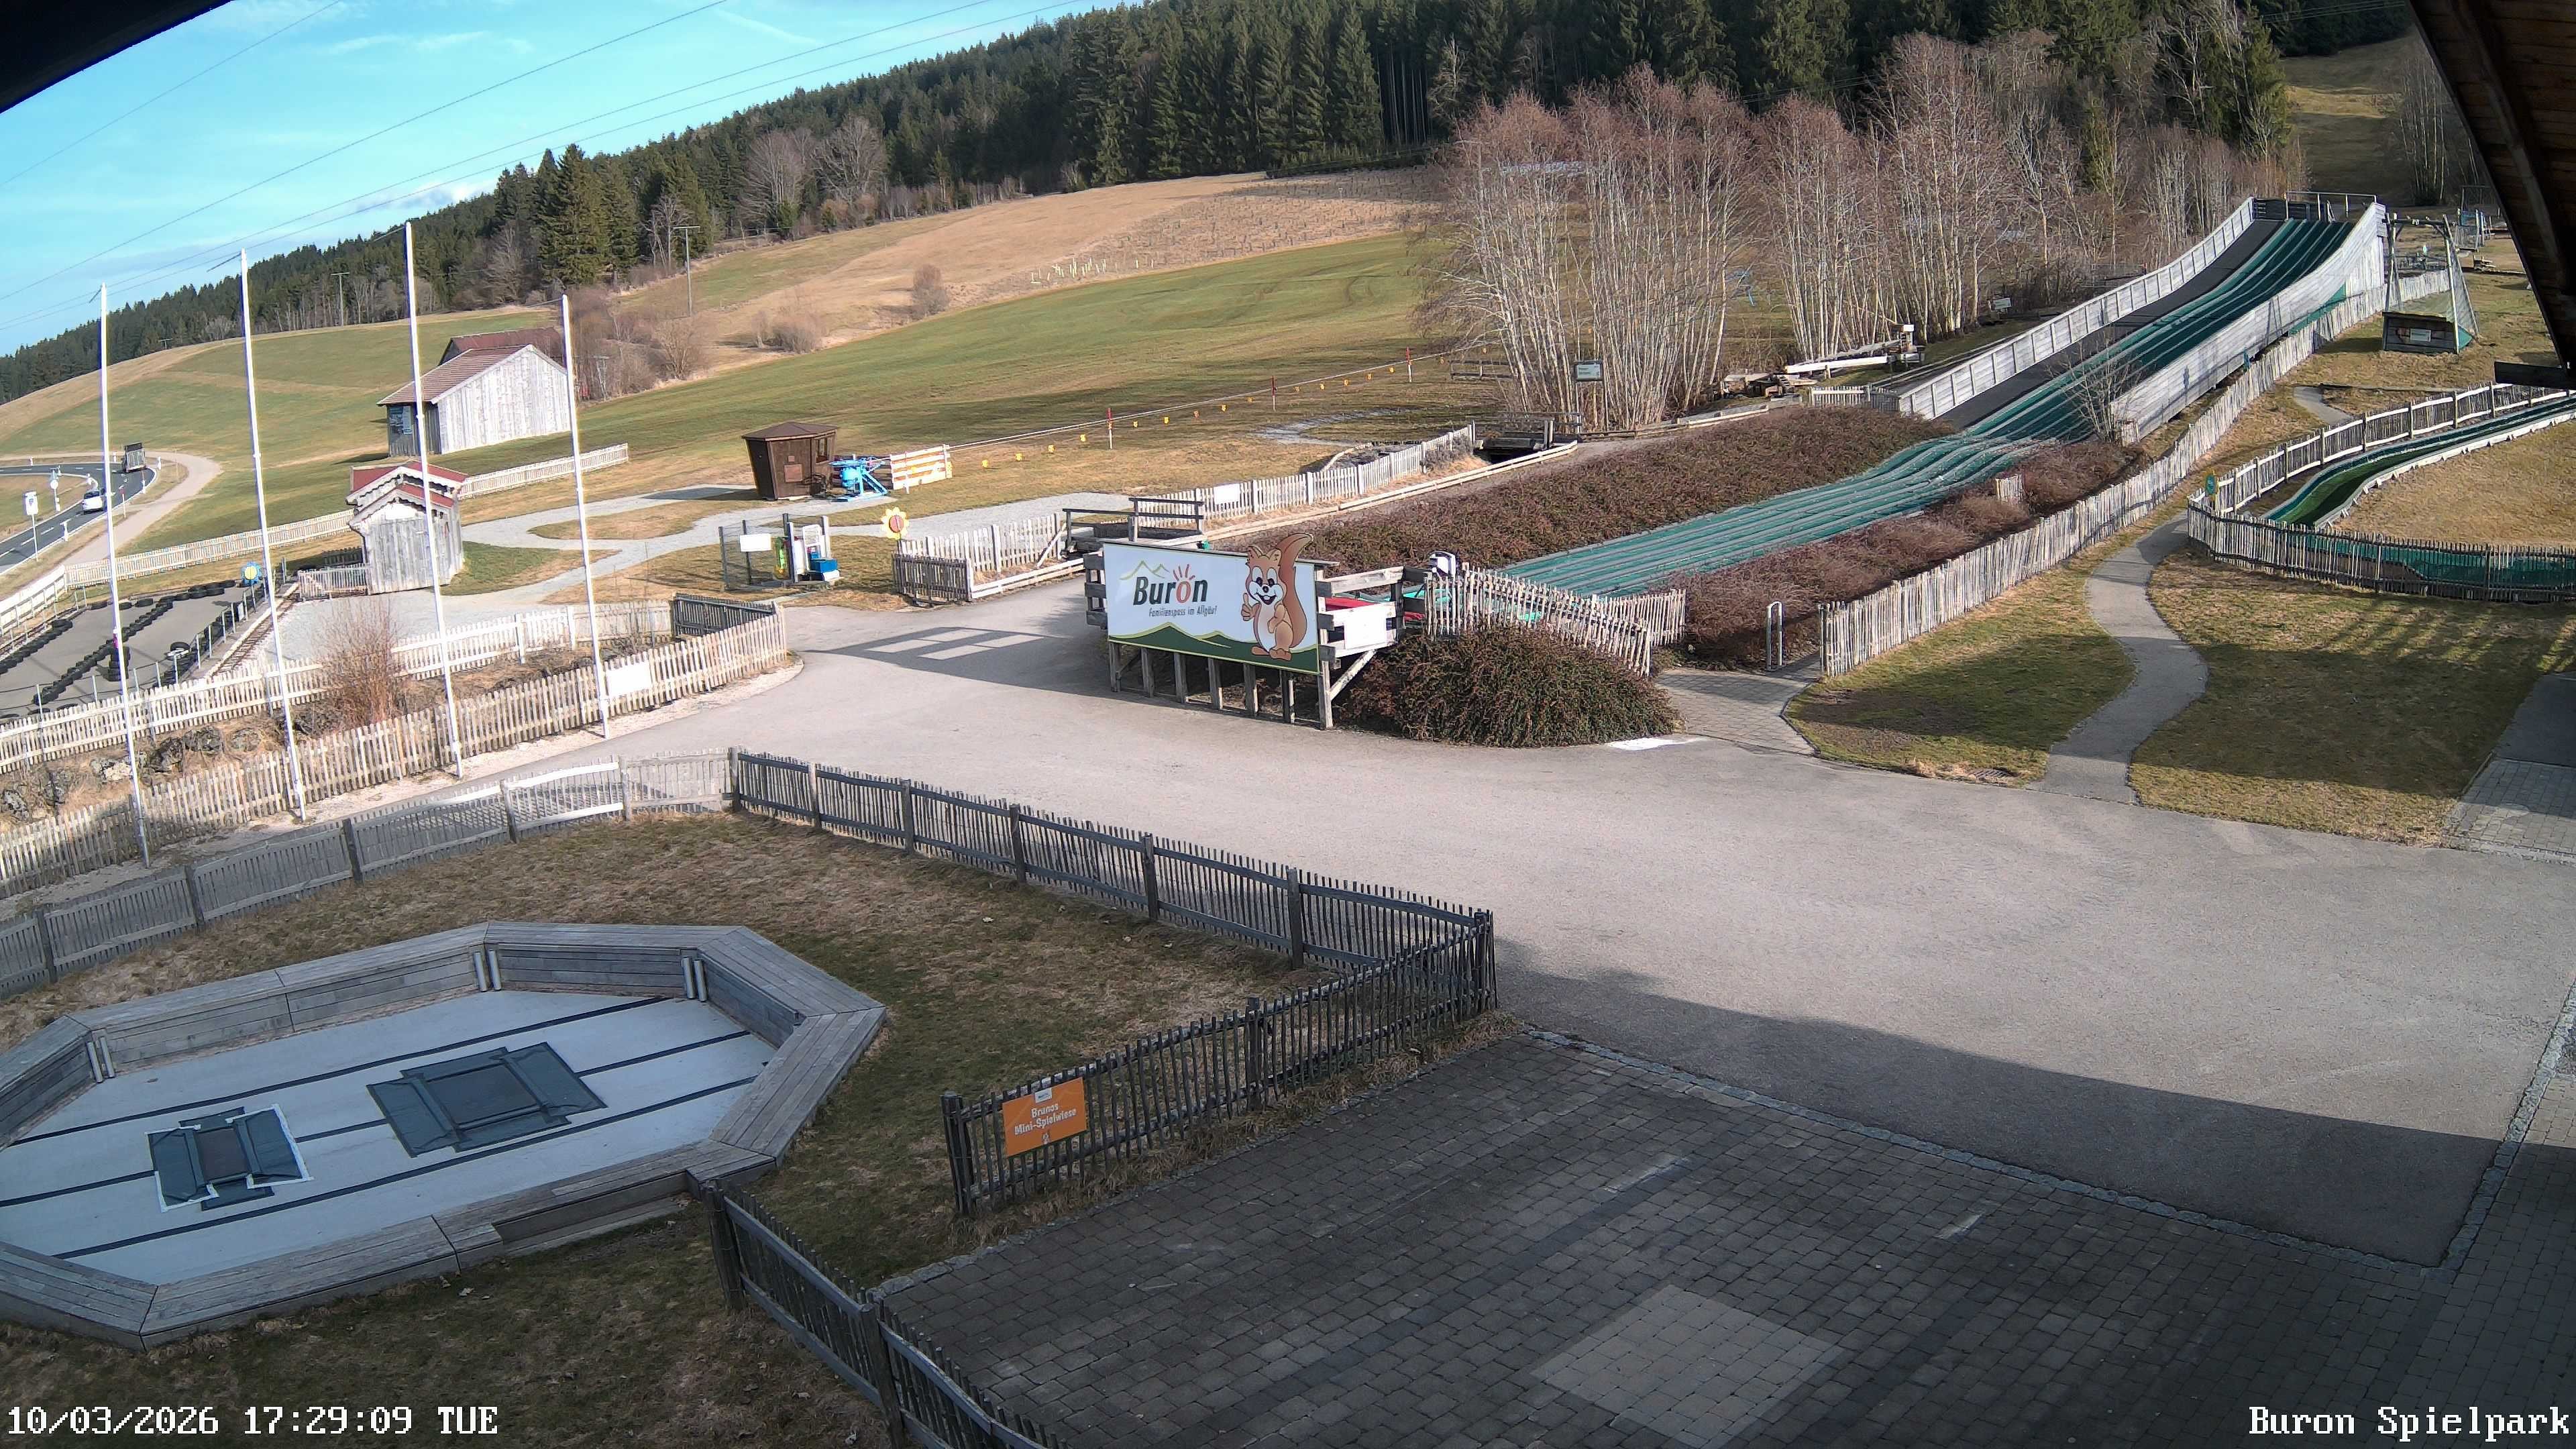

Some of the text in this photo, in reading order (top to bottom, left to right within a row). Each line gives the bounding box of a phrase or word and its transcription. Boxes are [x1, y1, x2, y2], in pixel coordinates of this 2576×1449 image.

[1133, 576, 1208, 605] Buron
[1014, 1109, 1076, 1135] Mini-Spielwiese
[1031, 1103, 1059, 1118] Brunos
